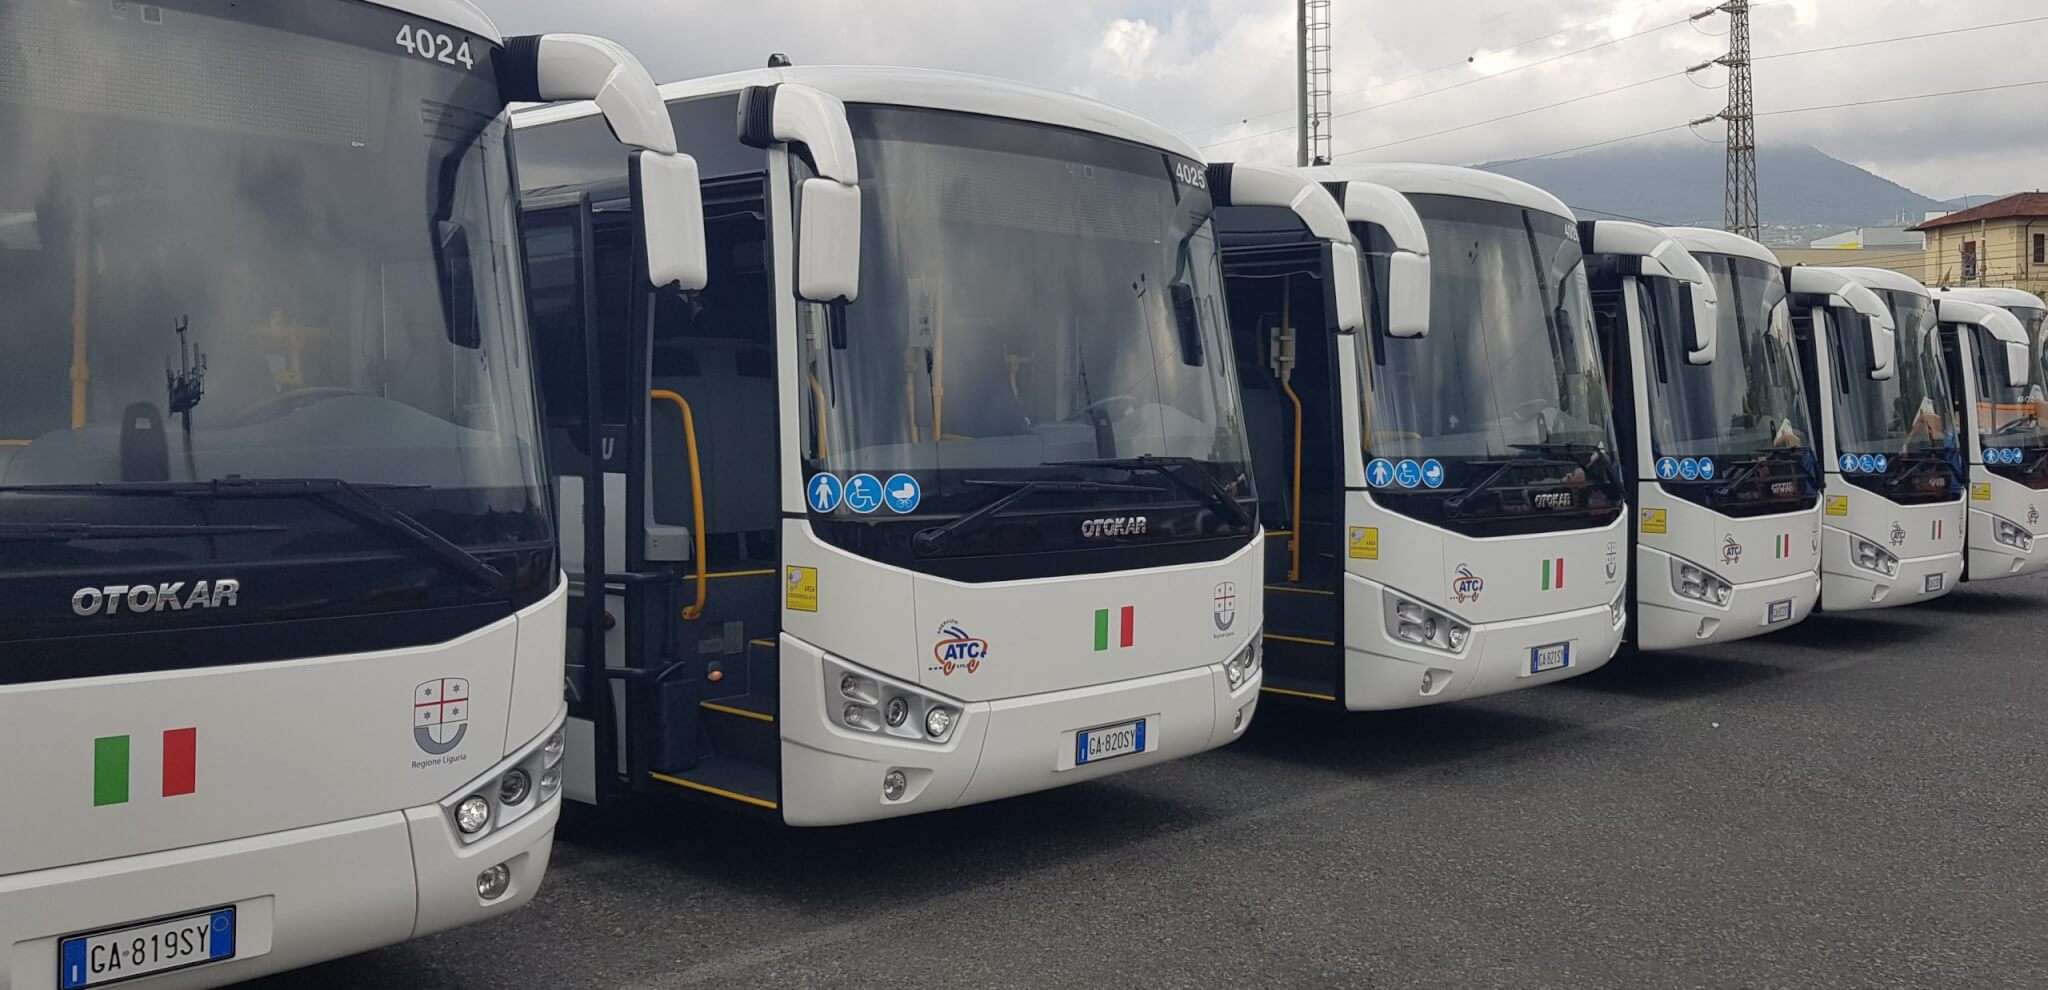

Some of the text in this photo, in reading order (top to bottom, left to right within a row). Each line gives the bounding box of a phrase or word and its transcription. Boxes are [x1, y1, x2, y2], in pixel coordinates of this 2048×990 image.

[396, 24, 474, 70] 4024
[1175, 162, 1206, 189] 4025
[602, 437, 615, 460] U
[1081, 516, 1147, 537] OTOKAR
[71, 578, 240, 616] OTOKAR
[1459, 580, 1479, 592] ATC
[944, 642, 980, 661] ATC
[411, 752, 467, 769] Regione Liguria
